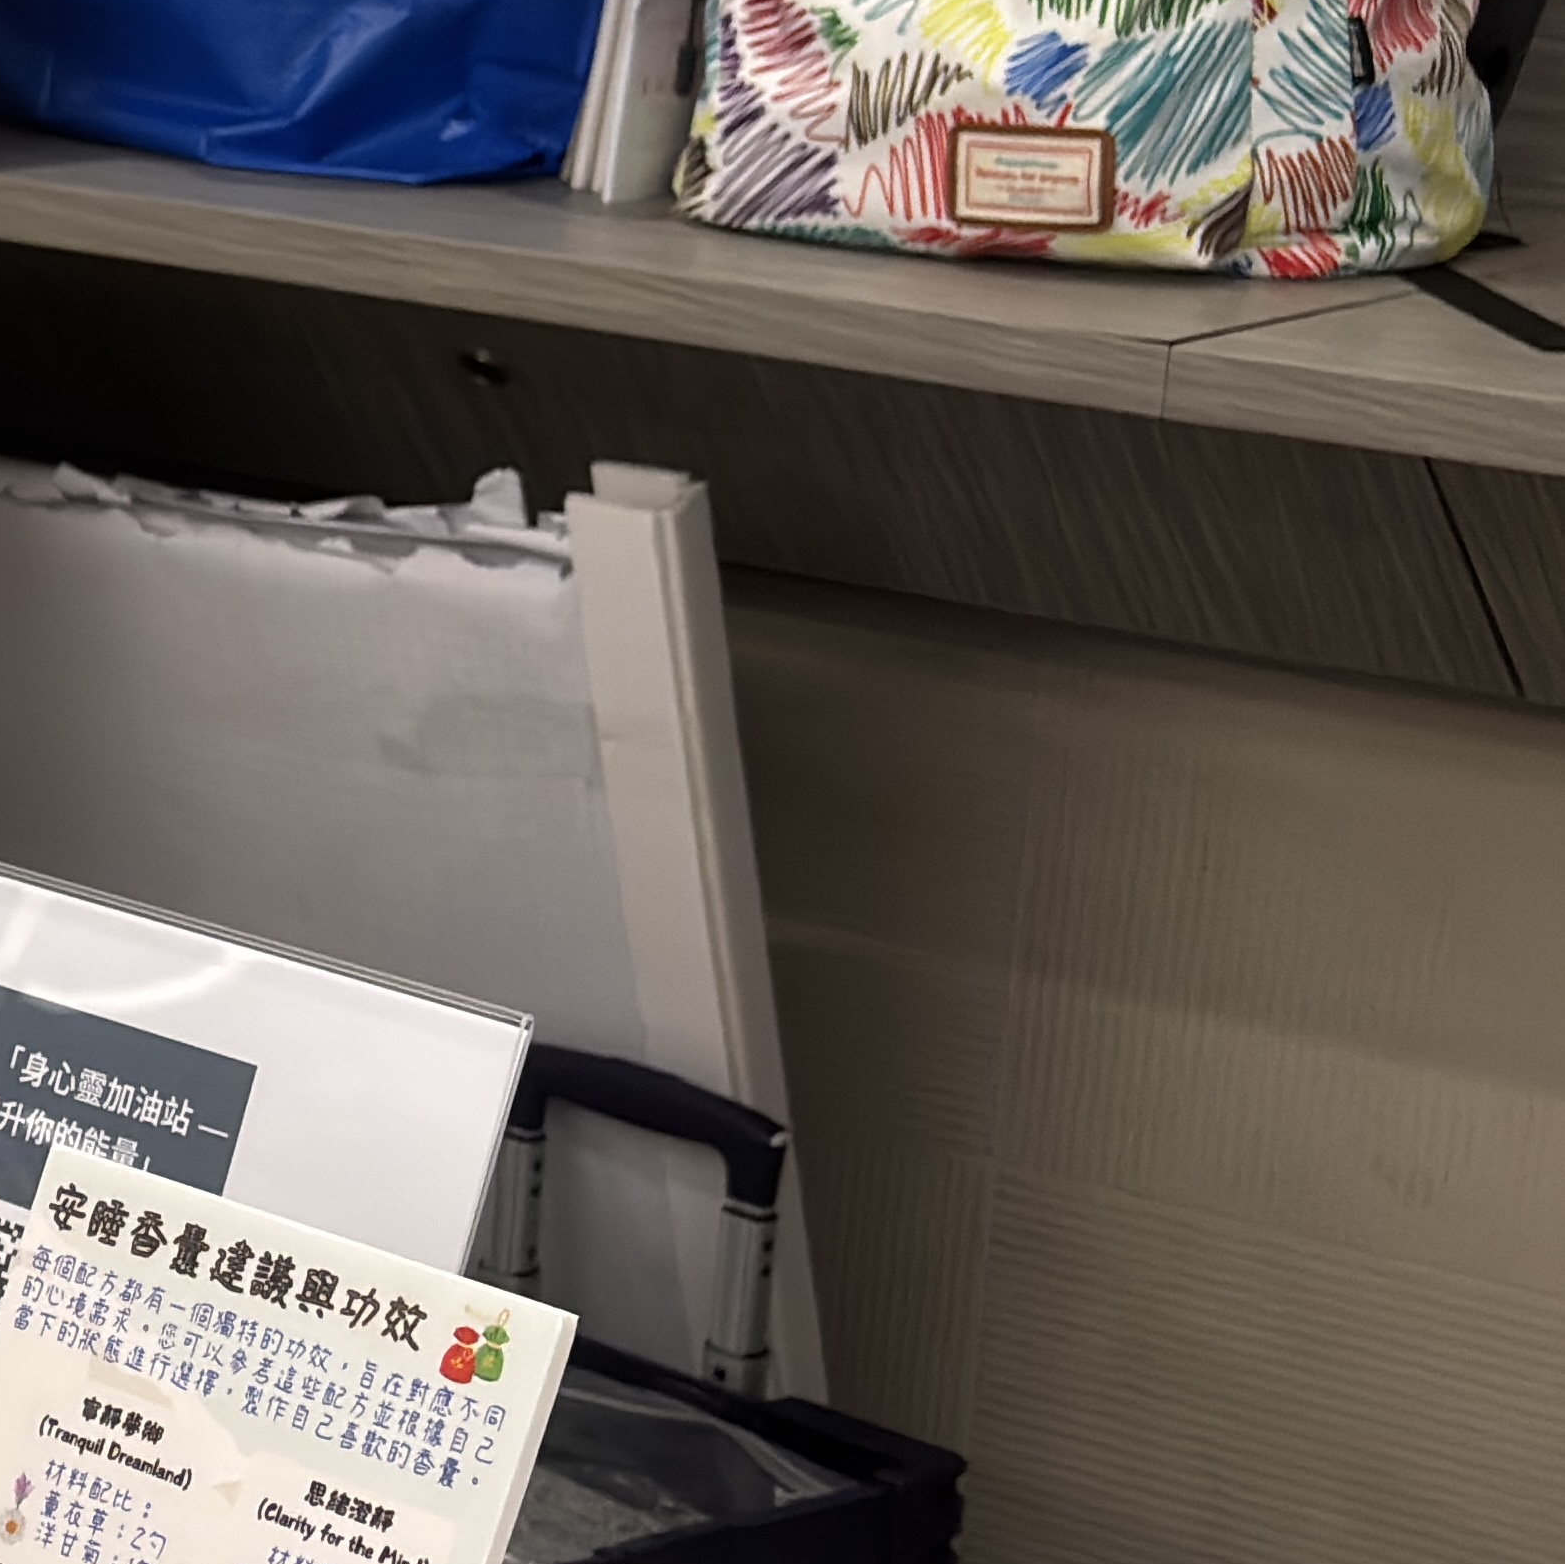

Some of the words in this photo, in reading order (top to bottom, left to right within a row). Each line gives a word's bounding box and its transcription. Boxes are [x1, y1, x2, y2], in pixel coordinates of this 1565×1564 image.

[48, 1182, 428, 1352] 安睡香囊建議與功效
[38, 1414, 107, 1456] (Tranquil
[106, 1440, 193, 1492] Dreamland)
[44, 1459, 153, 1519] 材料配比：
[257, 1497, 317, 1542] (Clarity
[320, 1523, 345, 1548] for
[348, 1535, 374, 1560] the
